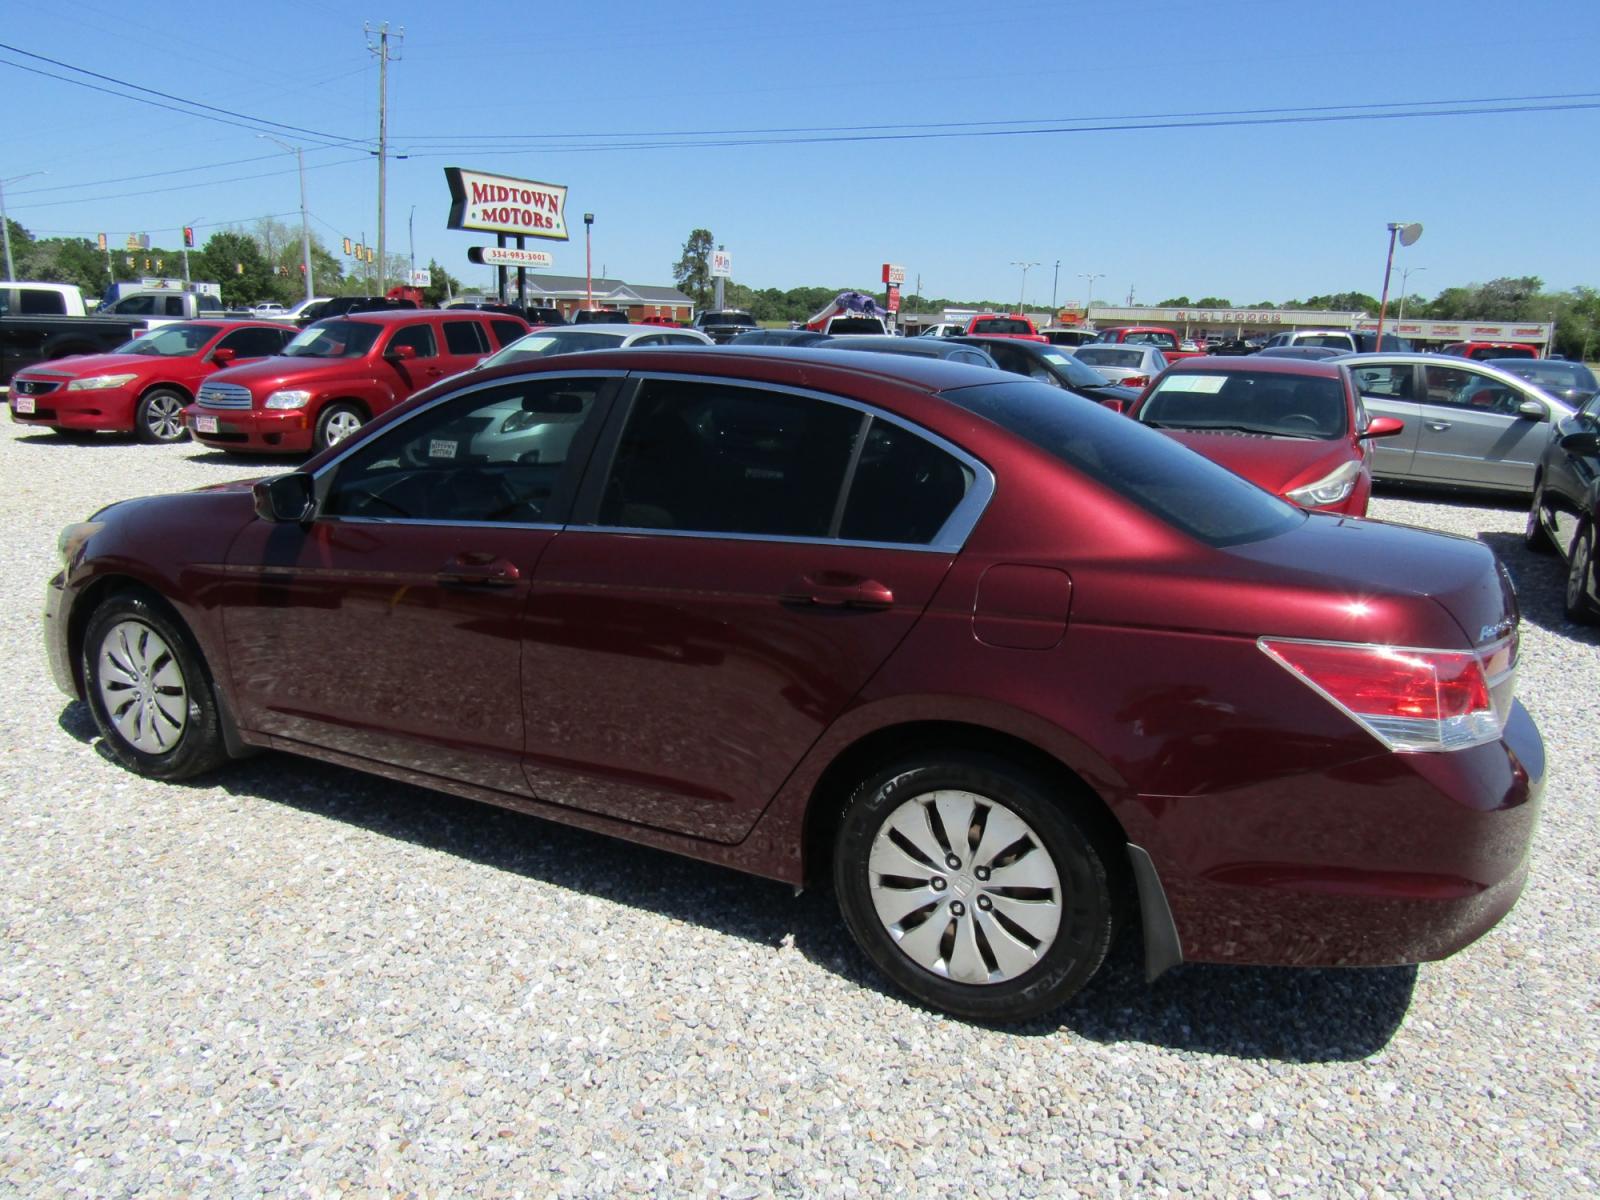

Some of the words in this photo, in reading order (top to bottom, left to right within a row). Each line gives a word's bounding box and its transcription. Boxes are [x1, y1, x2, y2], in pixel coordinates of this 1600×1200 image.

[471, 182, 559, 216] MIDTOWN
[481, 207, 554, 229] MOTORS
[492, 250, 546, 261] 334-983-3001
[1225, 312, 1281, 321] FOODS
